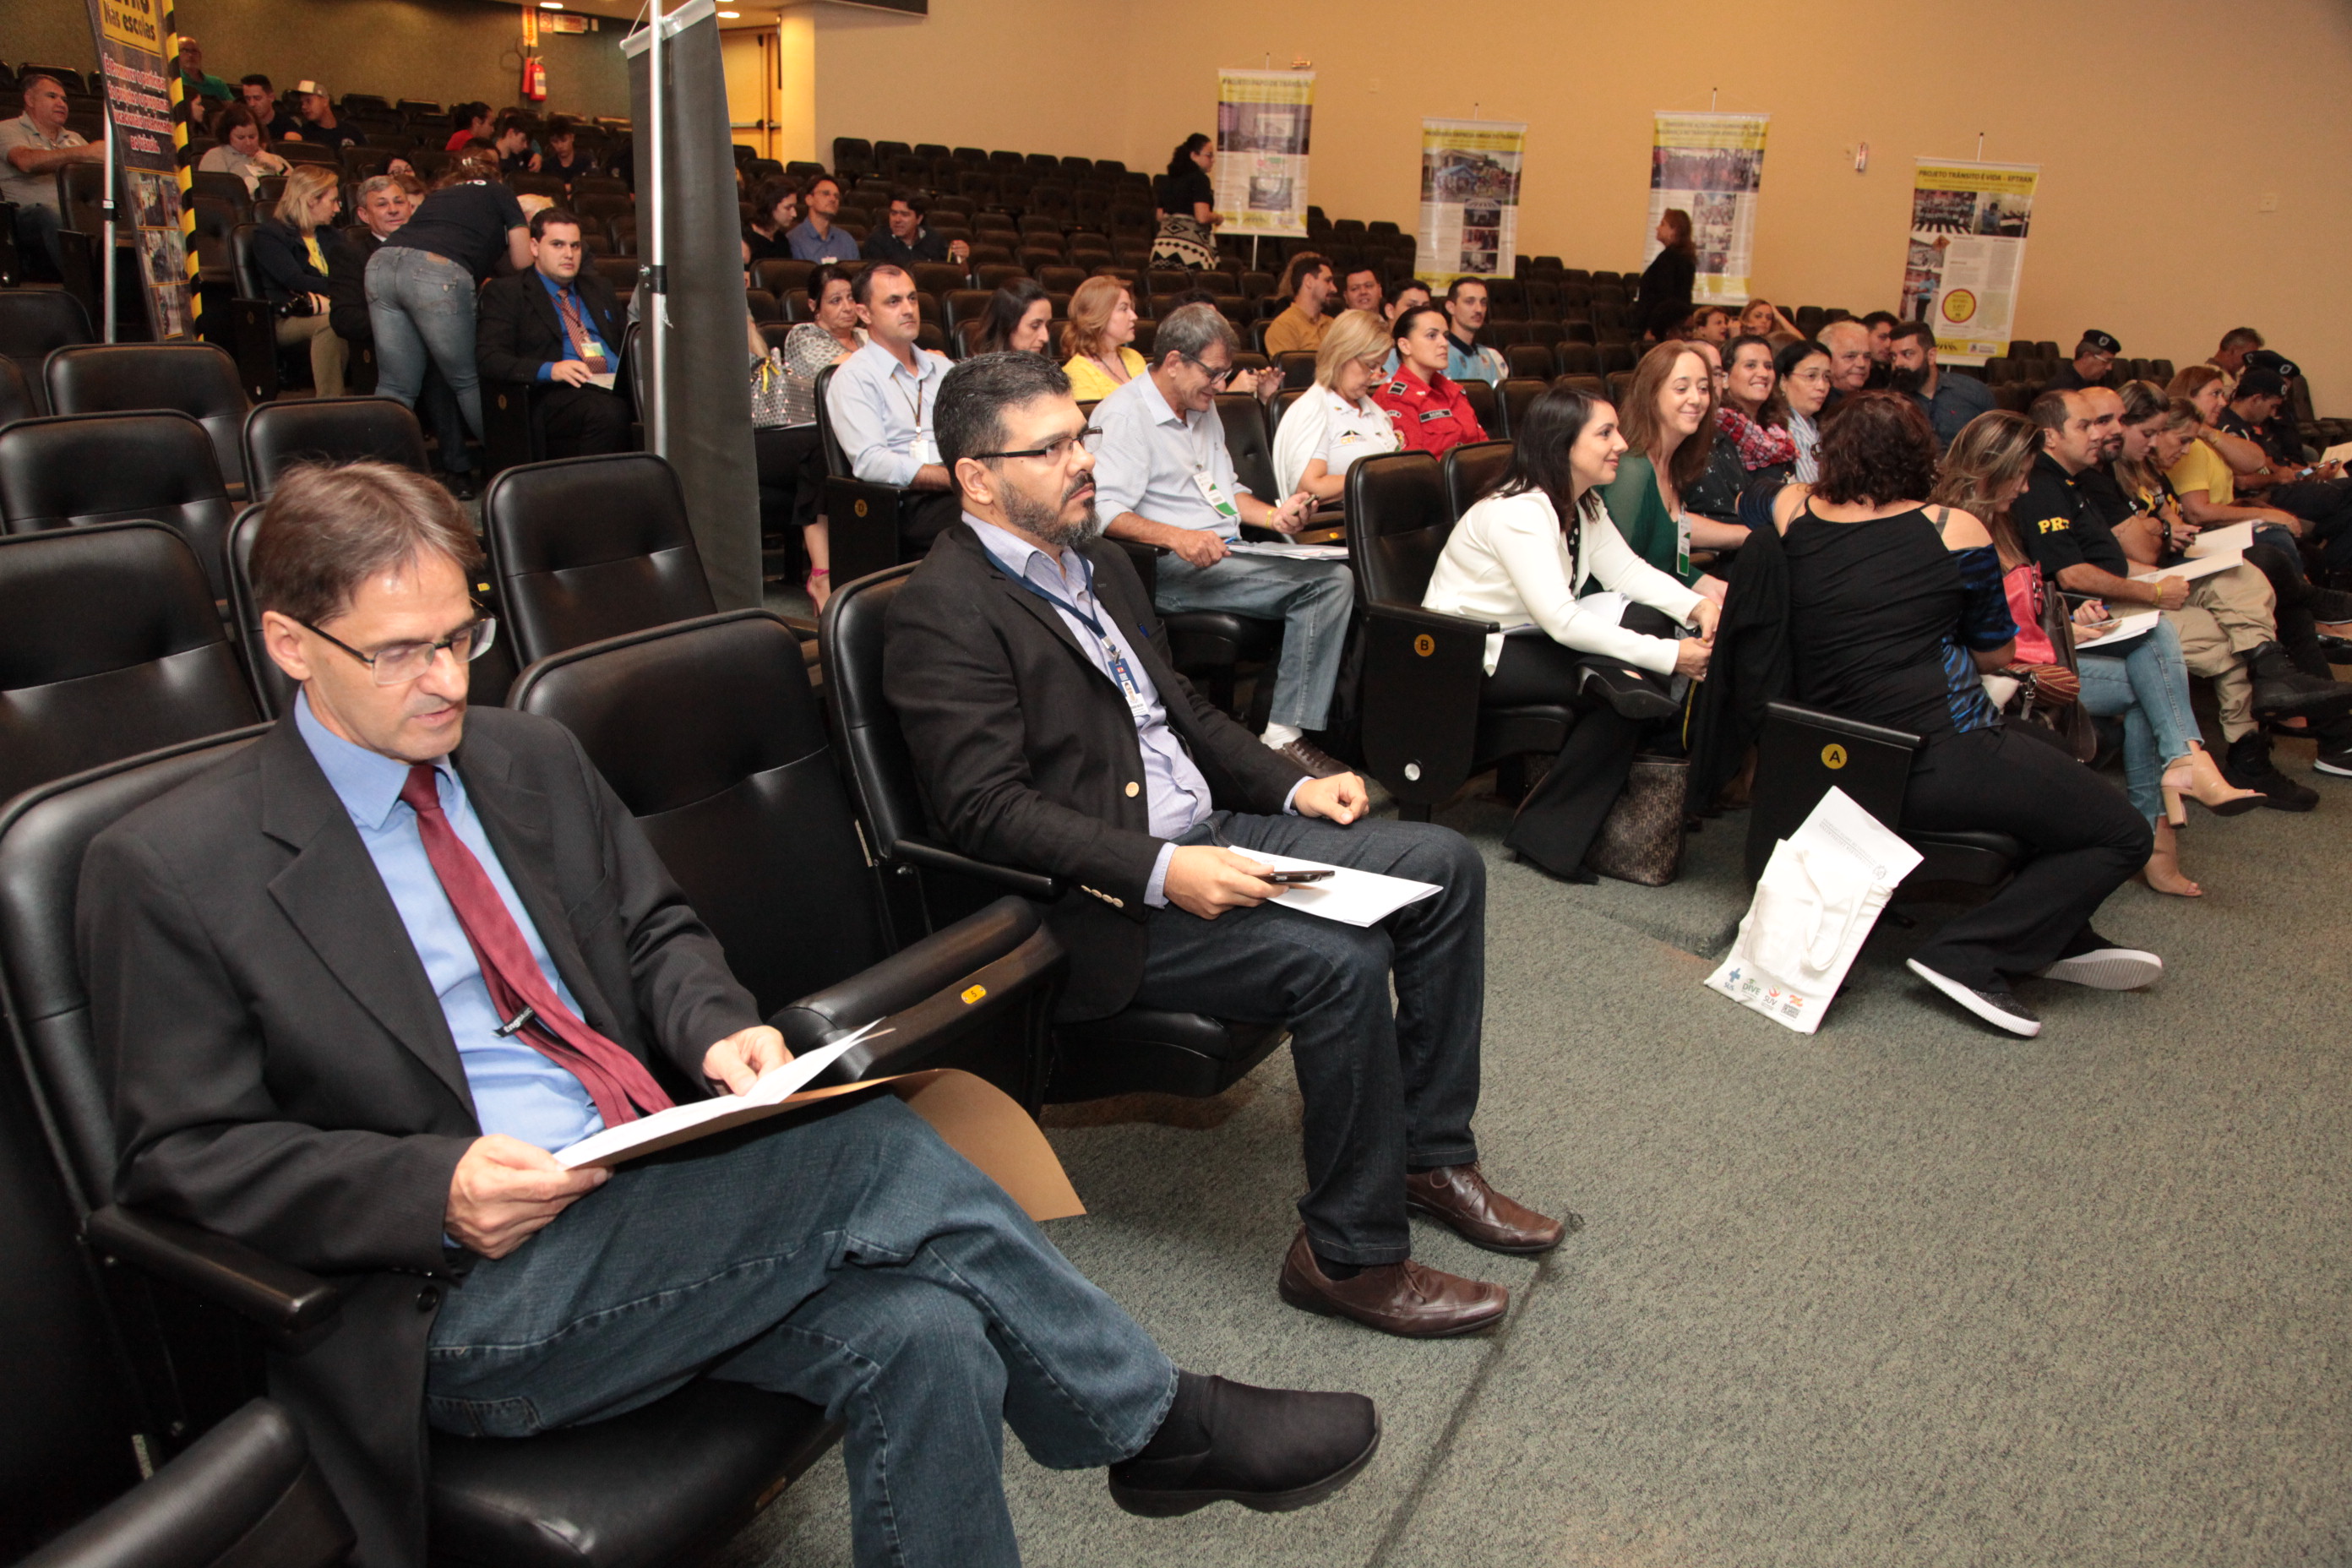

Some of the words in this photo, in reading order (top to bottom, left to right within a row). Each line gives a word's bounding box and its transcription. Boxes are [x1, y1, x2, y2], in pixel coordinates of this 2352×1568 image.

[122, 14, 156, 41] escolas
[1948, 171, 1980, 180] TRÂNSITO
[1421, 640, 1429, 651] B
[1829, 750, 1840, 764] A
[1742, 983, 1761, 995] DIVE
[1763, 995, 1778, 1005] SUV
